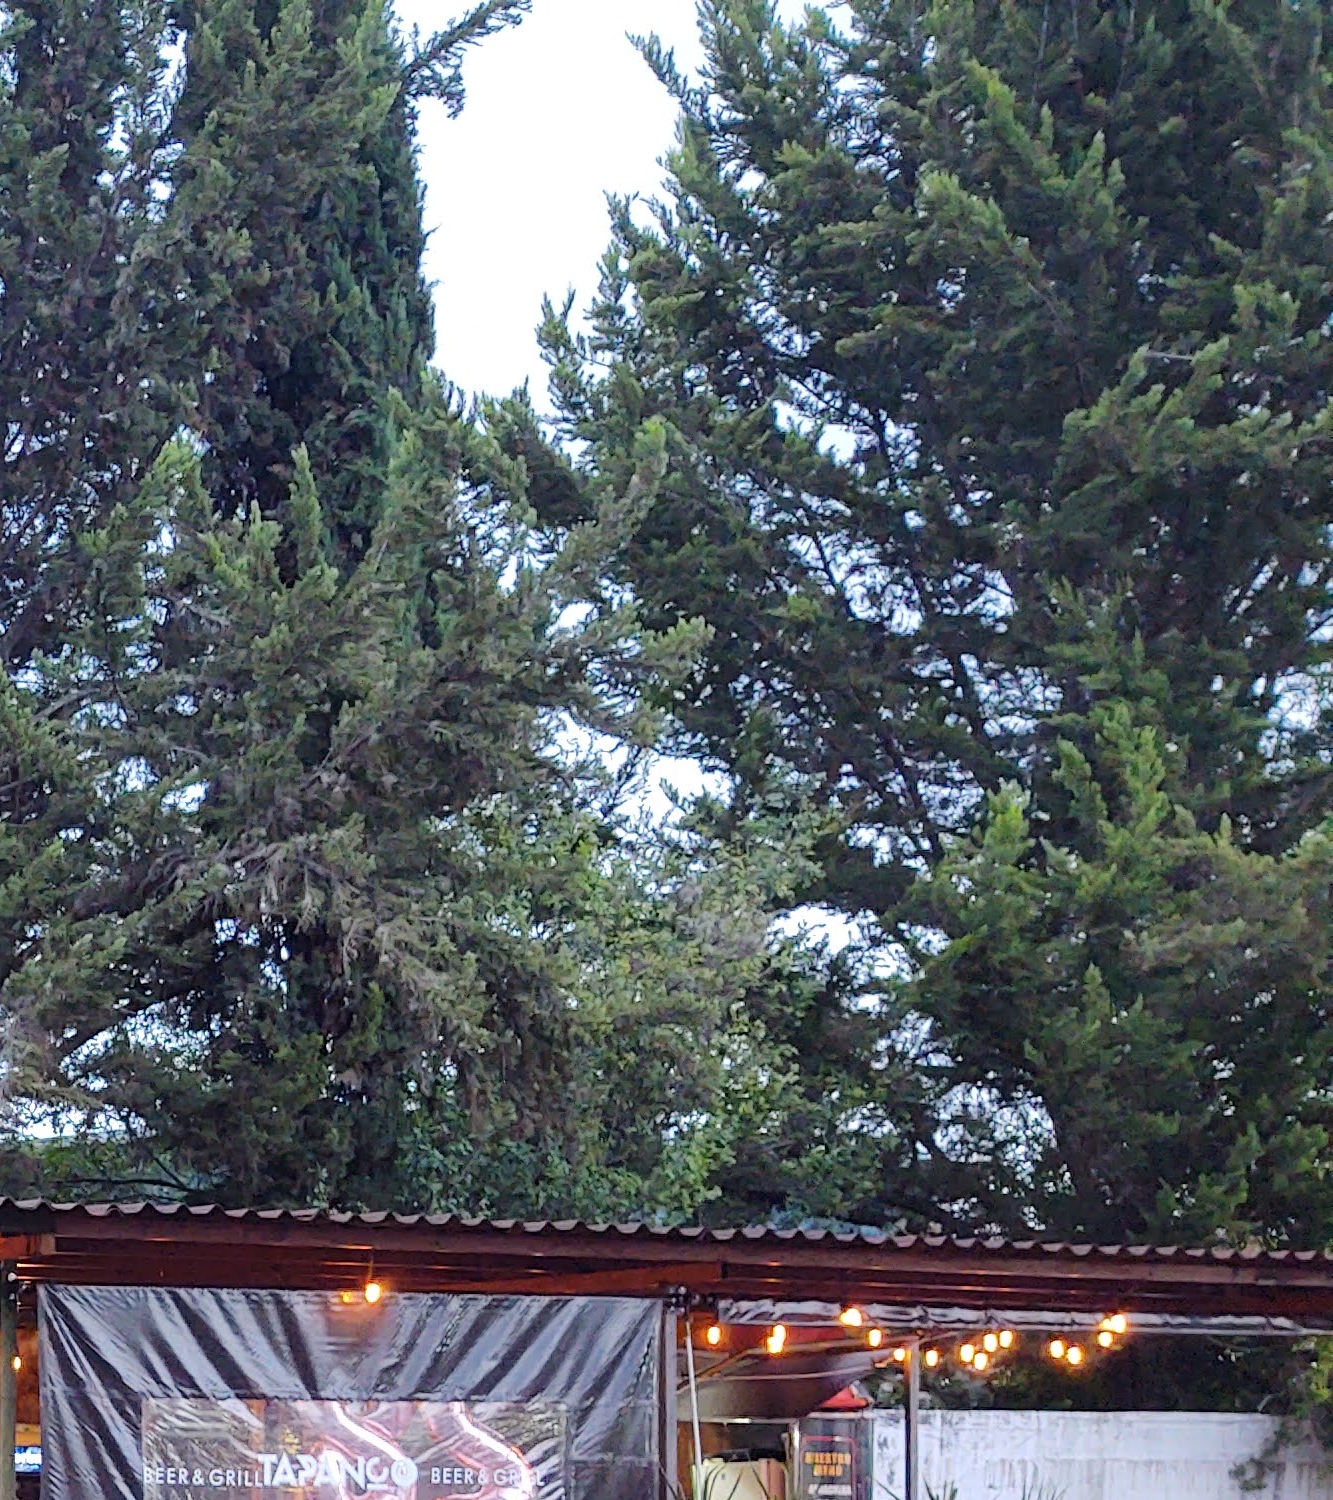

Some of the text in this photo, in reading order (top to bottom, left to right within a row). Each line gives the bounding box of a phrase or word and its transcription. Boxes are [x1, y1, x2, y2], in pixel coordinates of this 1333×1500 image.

[143, 1466, 263, 1487] BEER & GRILL
[431, 1467, 473, 1485] BEER
